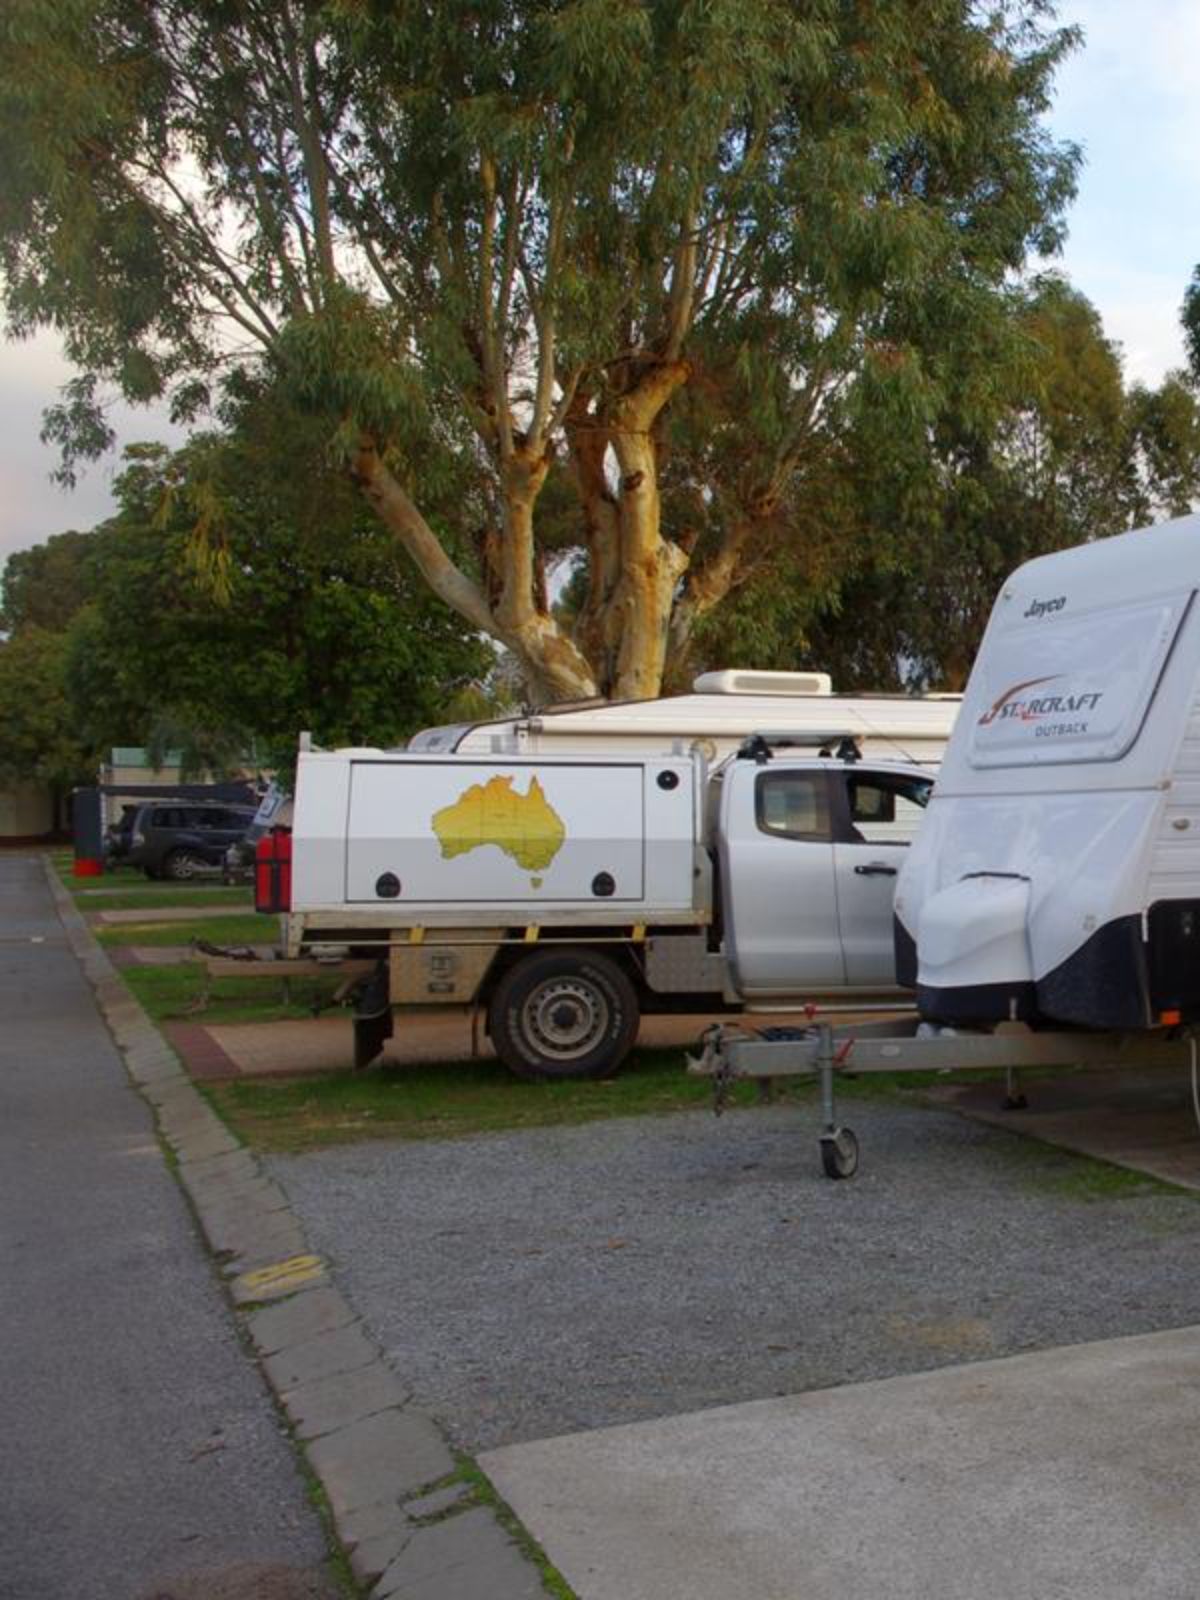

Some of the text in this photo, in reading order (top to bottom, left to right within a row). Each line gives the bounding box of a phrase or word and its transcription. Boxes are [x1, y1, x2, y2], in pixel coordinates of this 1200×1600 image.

[1023, 596, 1067, 618] Jayco
[1000, 693, 1103, 720] STARCRAFT
[1035, 722, 1089, 737] OUTBACK
